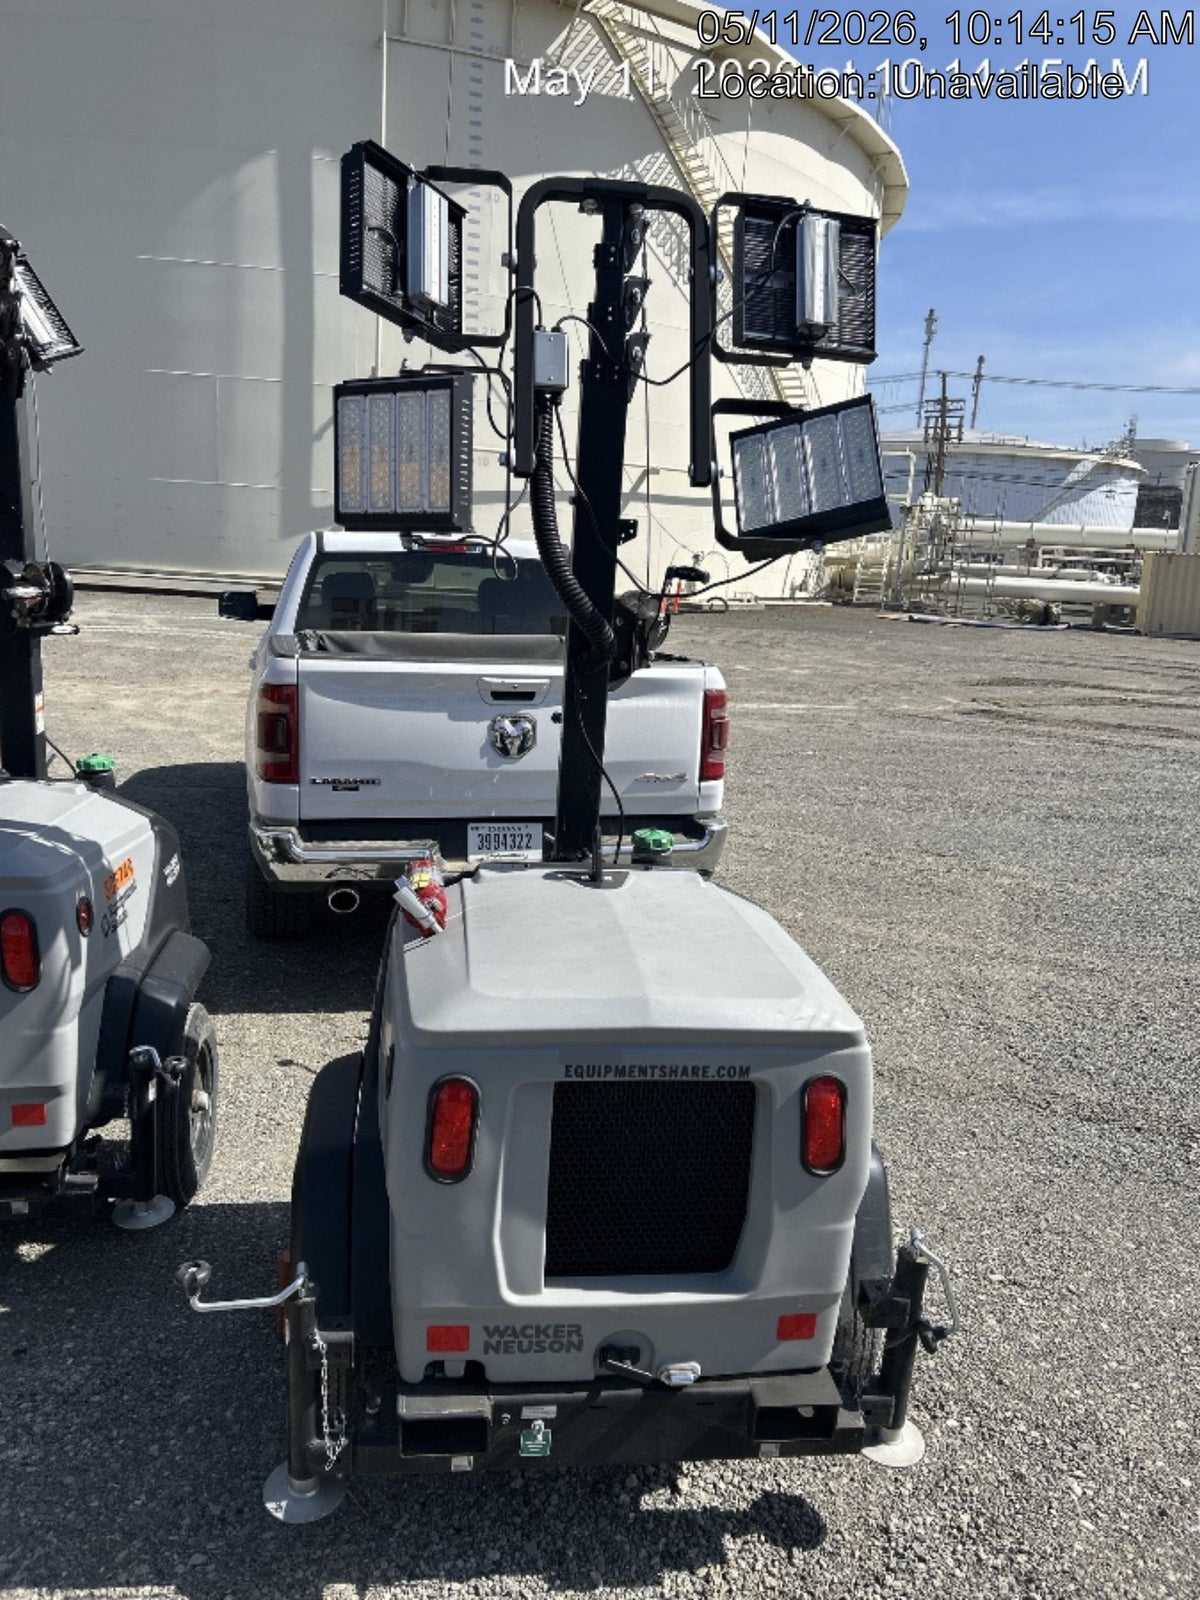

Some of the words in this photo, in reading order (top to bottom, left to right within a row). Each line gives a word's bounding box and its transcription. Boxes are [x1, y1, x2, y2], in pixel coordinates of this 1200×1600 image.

[477, 833, 532, 850] 3994322
[564, 1064, 751, 1080] EQUIPMENTSHARE.COM
[482, 1323, 584, 1339] WACKER
[483, 1338, 584, 1355] NEUSON
